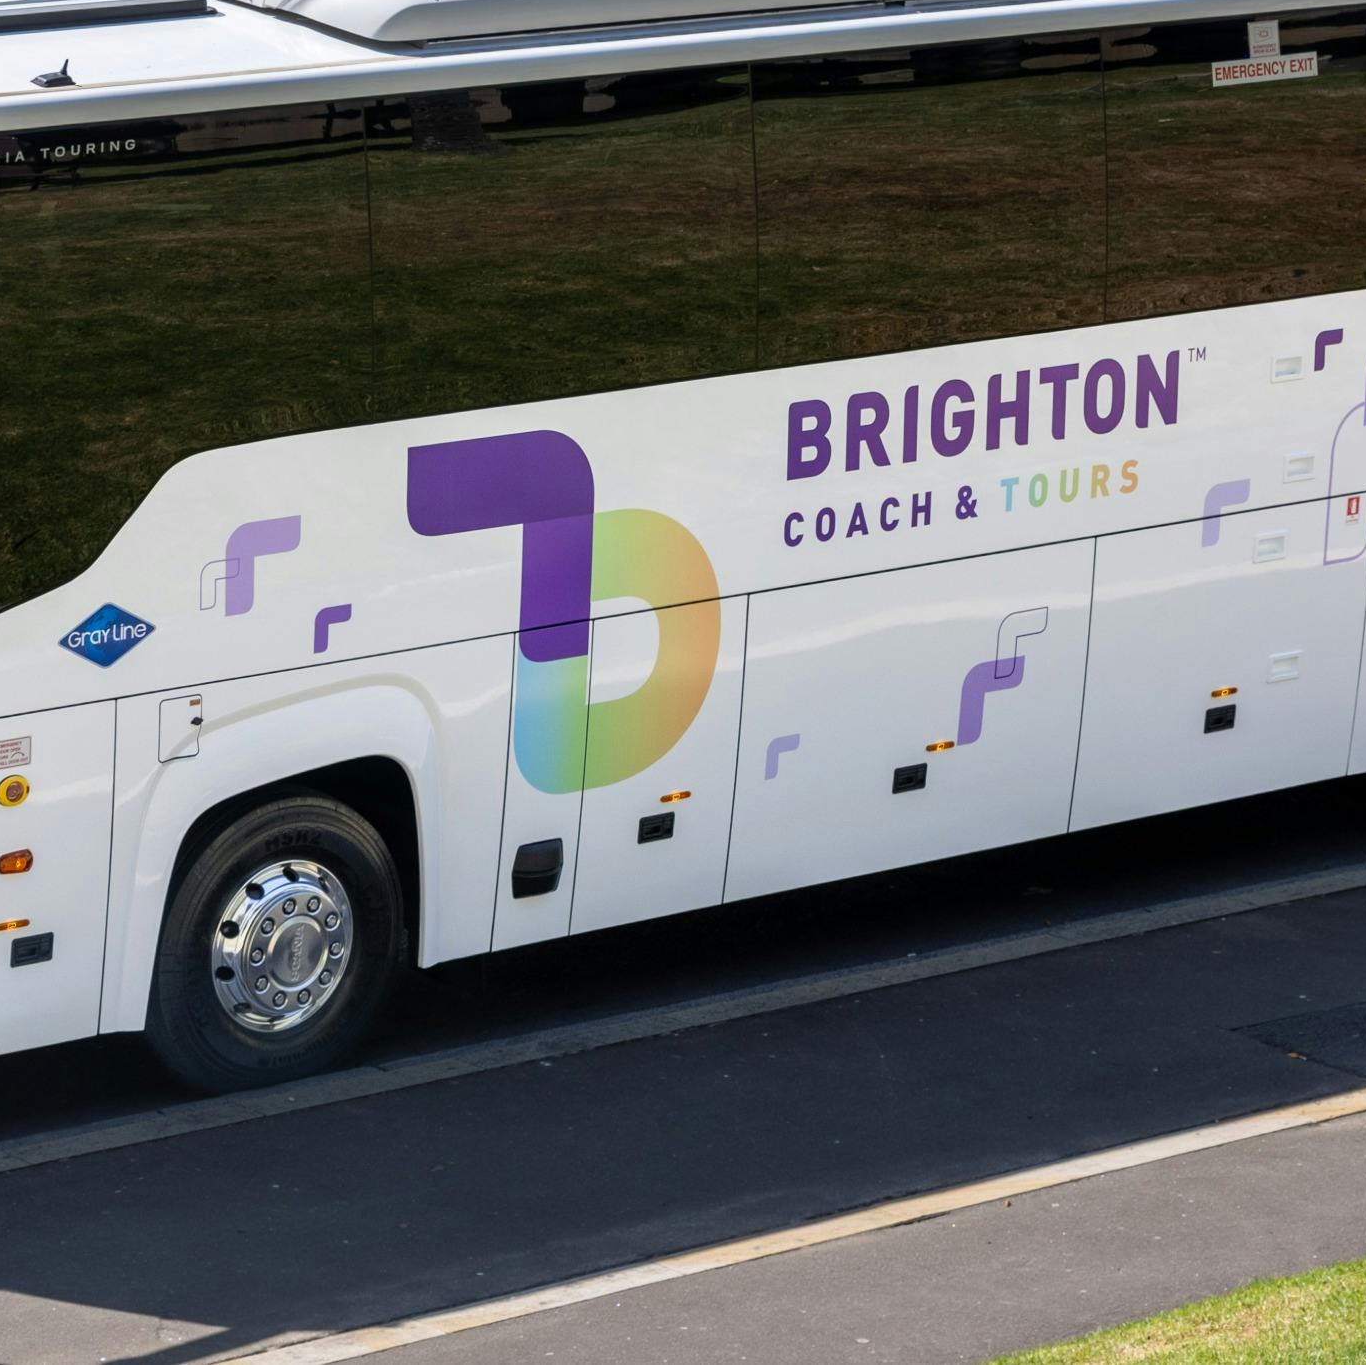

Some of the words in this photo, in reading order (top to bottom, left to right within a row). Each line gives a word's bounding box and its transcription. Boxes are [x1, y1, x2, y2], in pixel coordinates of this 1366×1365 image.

[1215, 60, 1287, 81] EMERGENCY
[1290, 57, 1315, 73] EXIT
[40, 139, 137, 159] TOURING
[786, 349, 1181, 481] BRIGHTON
[783, 491, 933, 548] COACH
[955, 485, 979, 520] &
[1000, 459, 1140, 513] TOURS
[67, 627, 111, 648] Gray
[112, 623, 147, 641] Line
